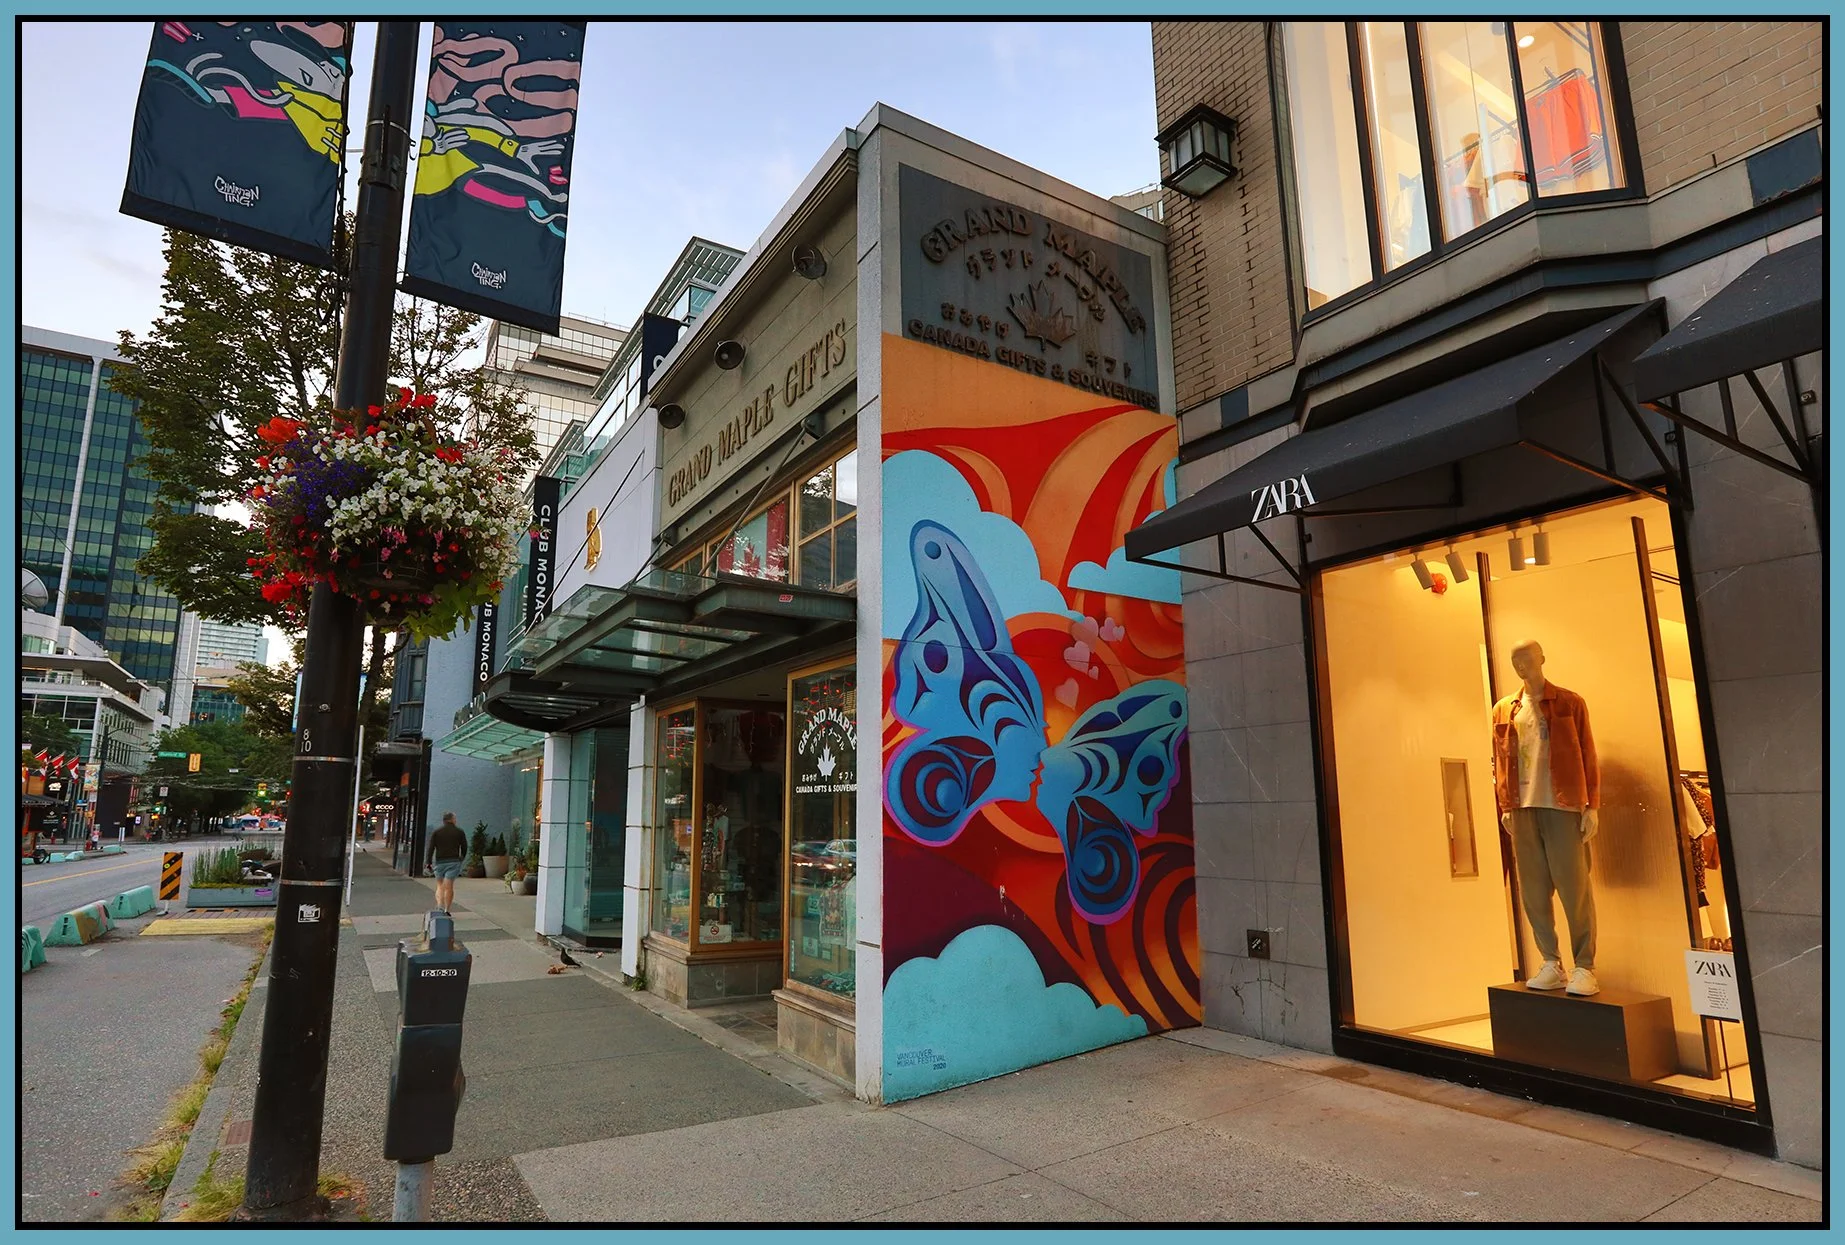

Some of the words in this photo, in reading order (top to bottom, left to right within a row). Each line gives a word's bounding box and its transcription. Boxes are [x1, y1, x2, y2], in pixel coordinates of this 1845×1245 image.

[920, 206, 1034, 263] GRAND
[1043, 222, 1147, 335] MAPLE
[908, 318, 992, 360] CANADA
[995, 344, 1048, 376] GIFTS
[1051, 363, 1065, 382] &
[1068, 368, 1158, 410] SOUVENIRS
[668, 442, 713, 508] GRAND
[717, 382, 775, 467] MAPLE
[783, 317, 847, 408] GIFTS
[1250, 473, 1320, 523] ZARA
[534, 557, 548, 624] MONAC
[479, 621, 492, 682] MONACO
[300, 740, 312, 752] 10
[303, 728, 310, 741] 8
[798, 708, 827, 756] GRAND
[827, 706, 857, 751] MAPLE
[795, 785, 813, 794] CANADA
[814, 784, 828, 793] GIFTS
[828, 784, 833, 792] &
[1694, 960, 1732, 978] ZARA
